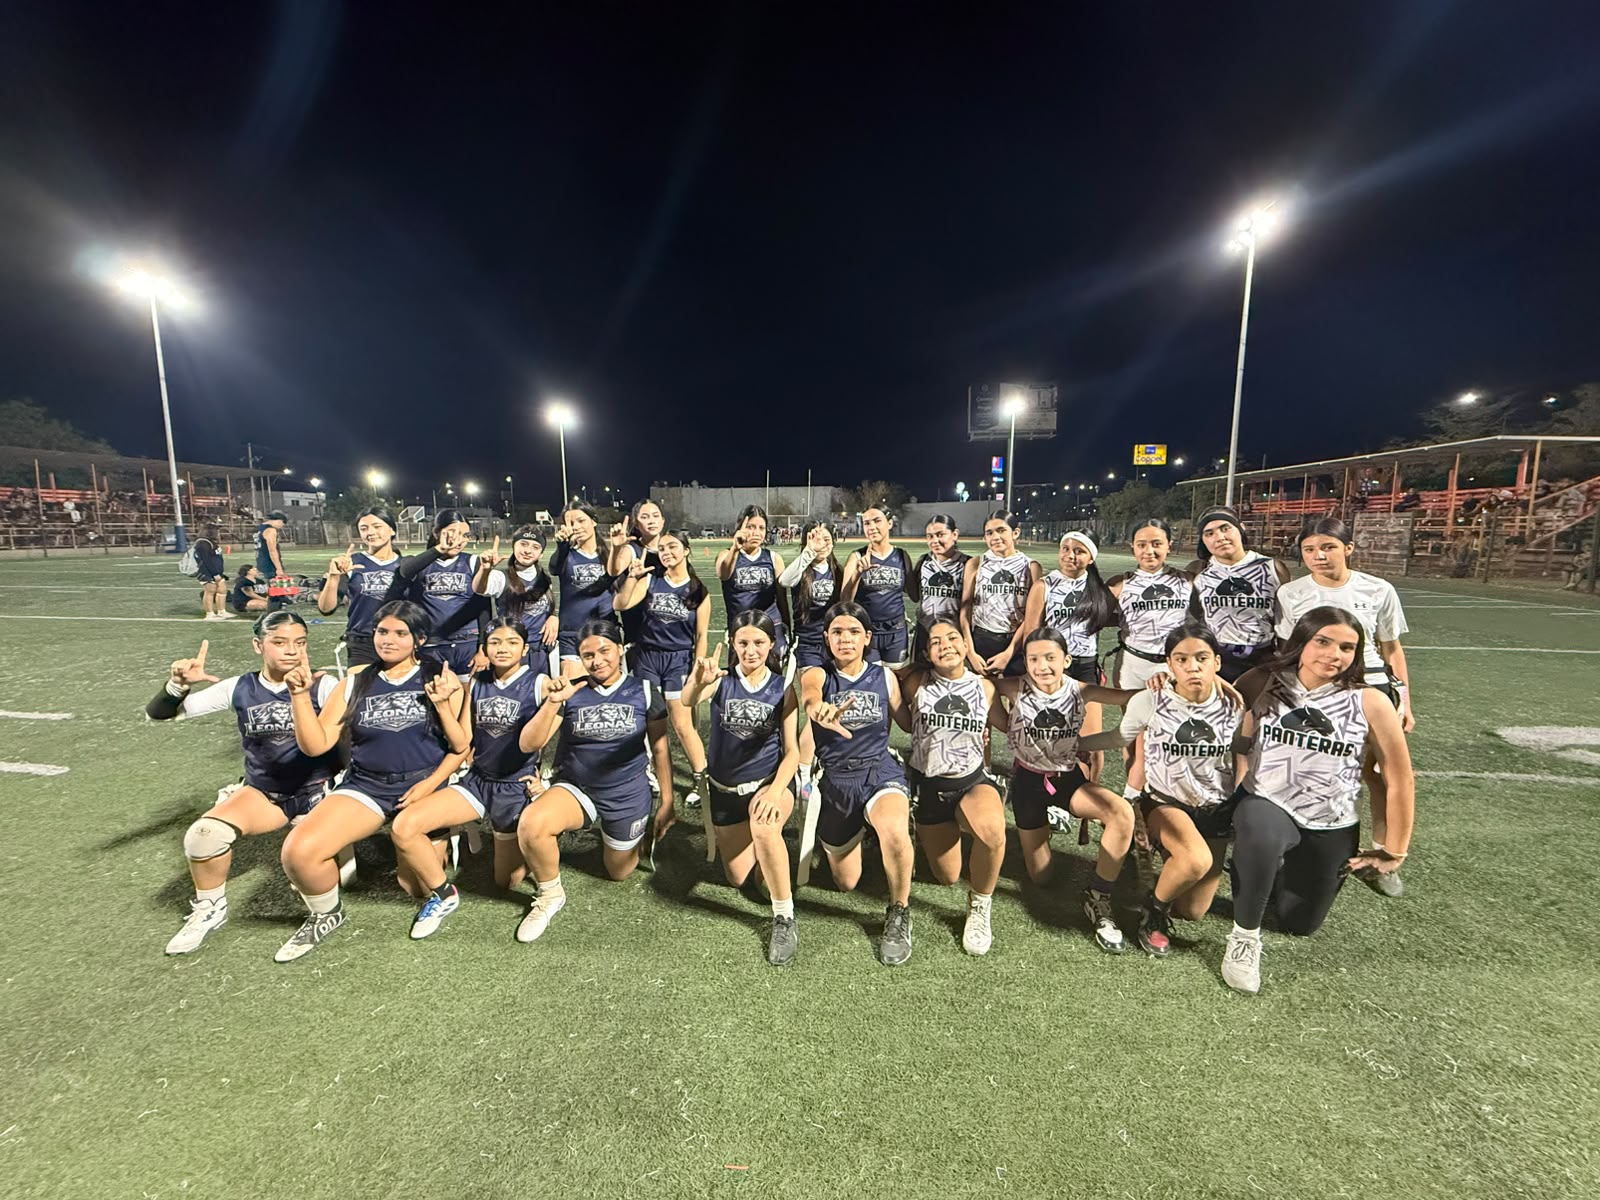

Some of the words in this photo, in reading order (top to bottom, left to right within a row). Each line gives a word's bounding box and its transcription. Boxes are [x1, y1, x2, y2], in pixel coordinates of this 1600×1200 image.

[365, 583, 390, 591] LEON
[426, 584, 466, 592] LEONAS
[982, 584, 1024, 596] PANTERAS
[1131, 599, 1186, 611] PANTERAS
[1204, 596, 1271, 609] PANTERAS
[651, 603, 688, 617] LEONAS
[364, 704, 427, 721] LEONAS
[843, 708, 882, 717] ONAS
[477, 715, 516, 726] LEONAS
[577, 719, 634, 732] LEONAS
[723, 716, 772, 729] LEONAS
[921, 713, 983, 733] PANTERAS
[248, 722, 295, 734] LEONA
[1024, 727, 1078, 740] PANTERAS
[1263, 724, 1355, 757] PANTERAS
